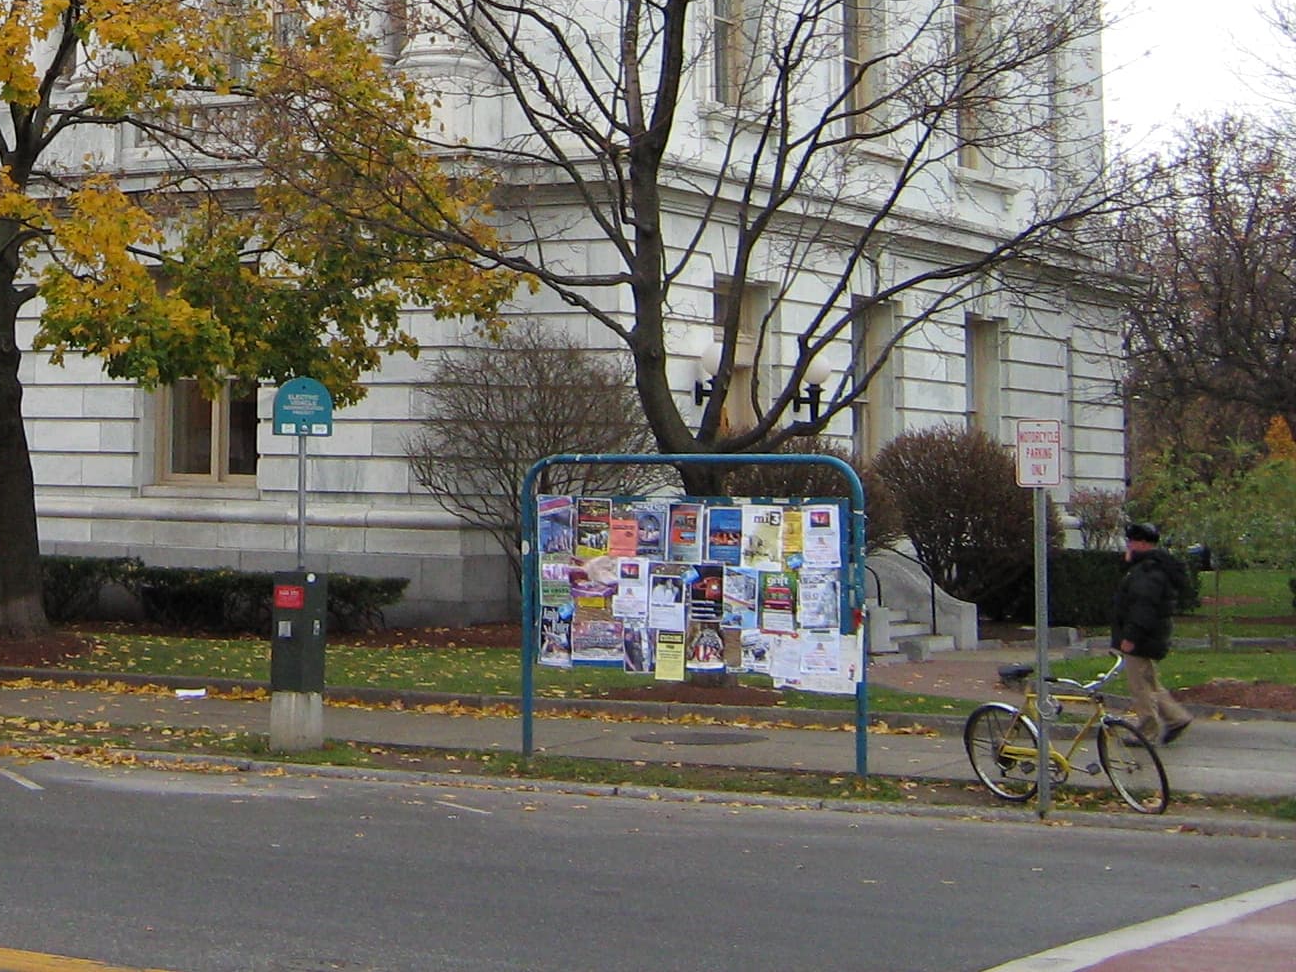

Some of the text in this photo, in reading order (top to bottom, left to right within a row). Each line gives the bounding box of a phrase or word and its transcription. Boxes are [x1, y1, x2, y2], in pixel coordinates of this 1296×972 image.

[1019, 431, 1059, 443] MOTORCYCLE
[1026, 447, 1052, 459] PARKING
[1031, 464, 1047, 476] ONLY
